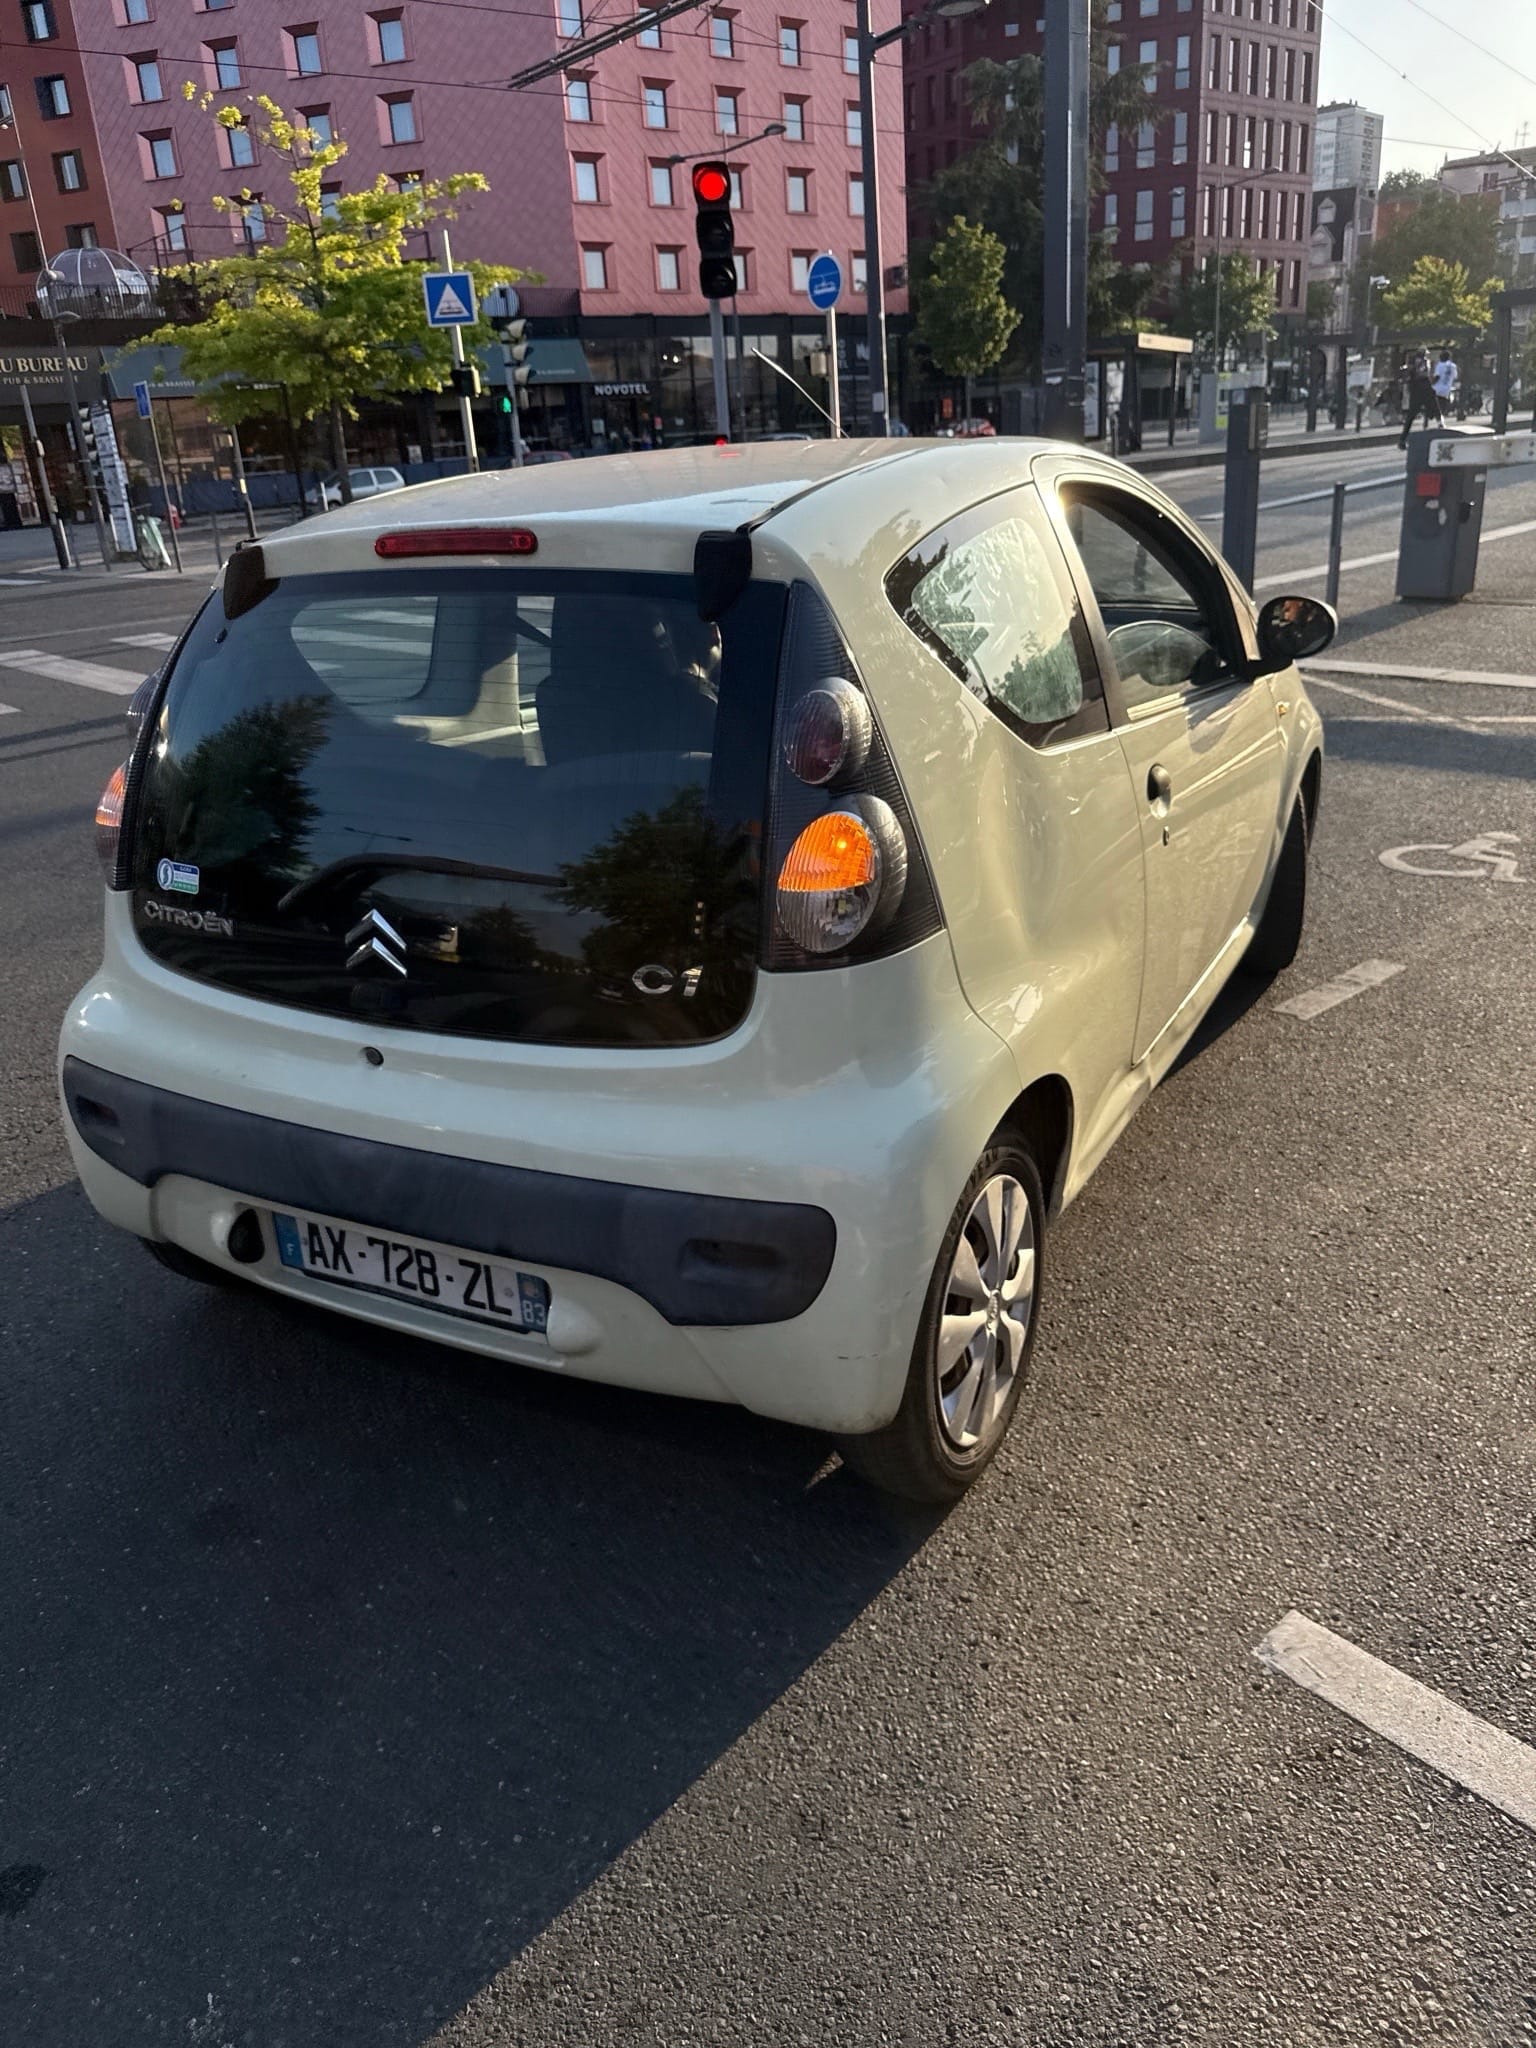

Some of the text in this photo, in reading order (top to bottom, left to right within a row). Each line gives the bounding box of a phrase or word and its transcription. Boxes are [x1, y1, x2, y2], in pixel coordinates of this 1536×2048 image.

[0, 356, 88, 373] U BUREAU
[594, 384, 649, 395] NOVOTEL
[144, 900, 233, 937] CITROËN
[632, 964, 703, 997] C1
[305, 1221, 513, 1316] AX-728-ZL
